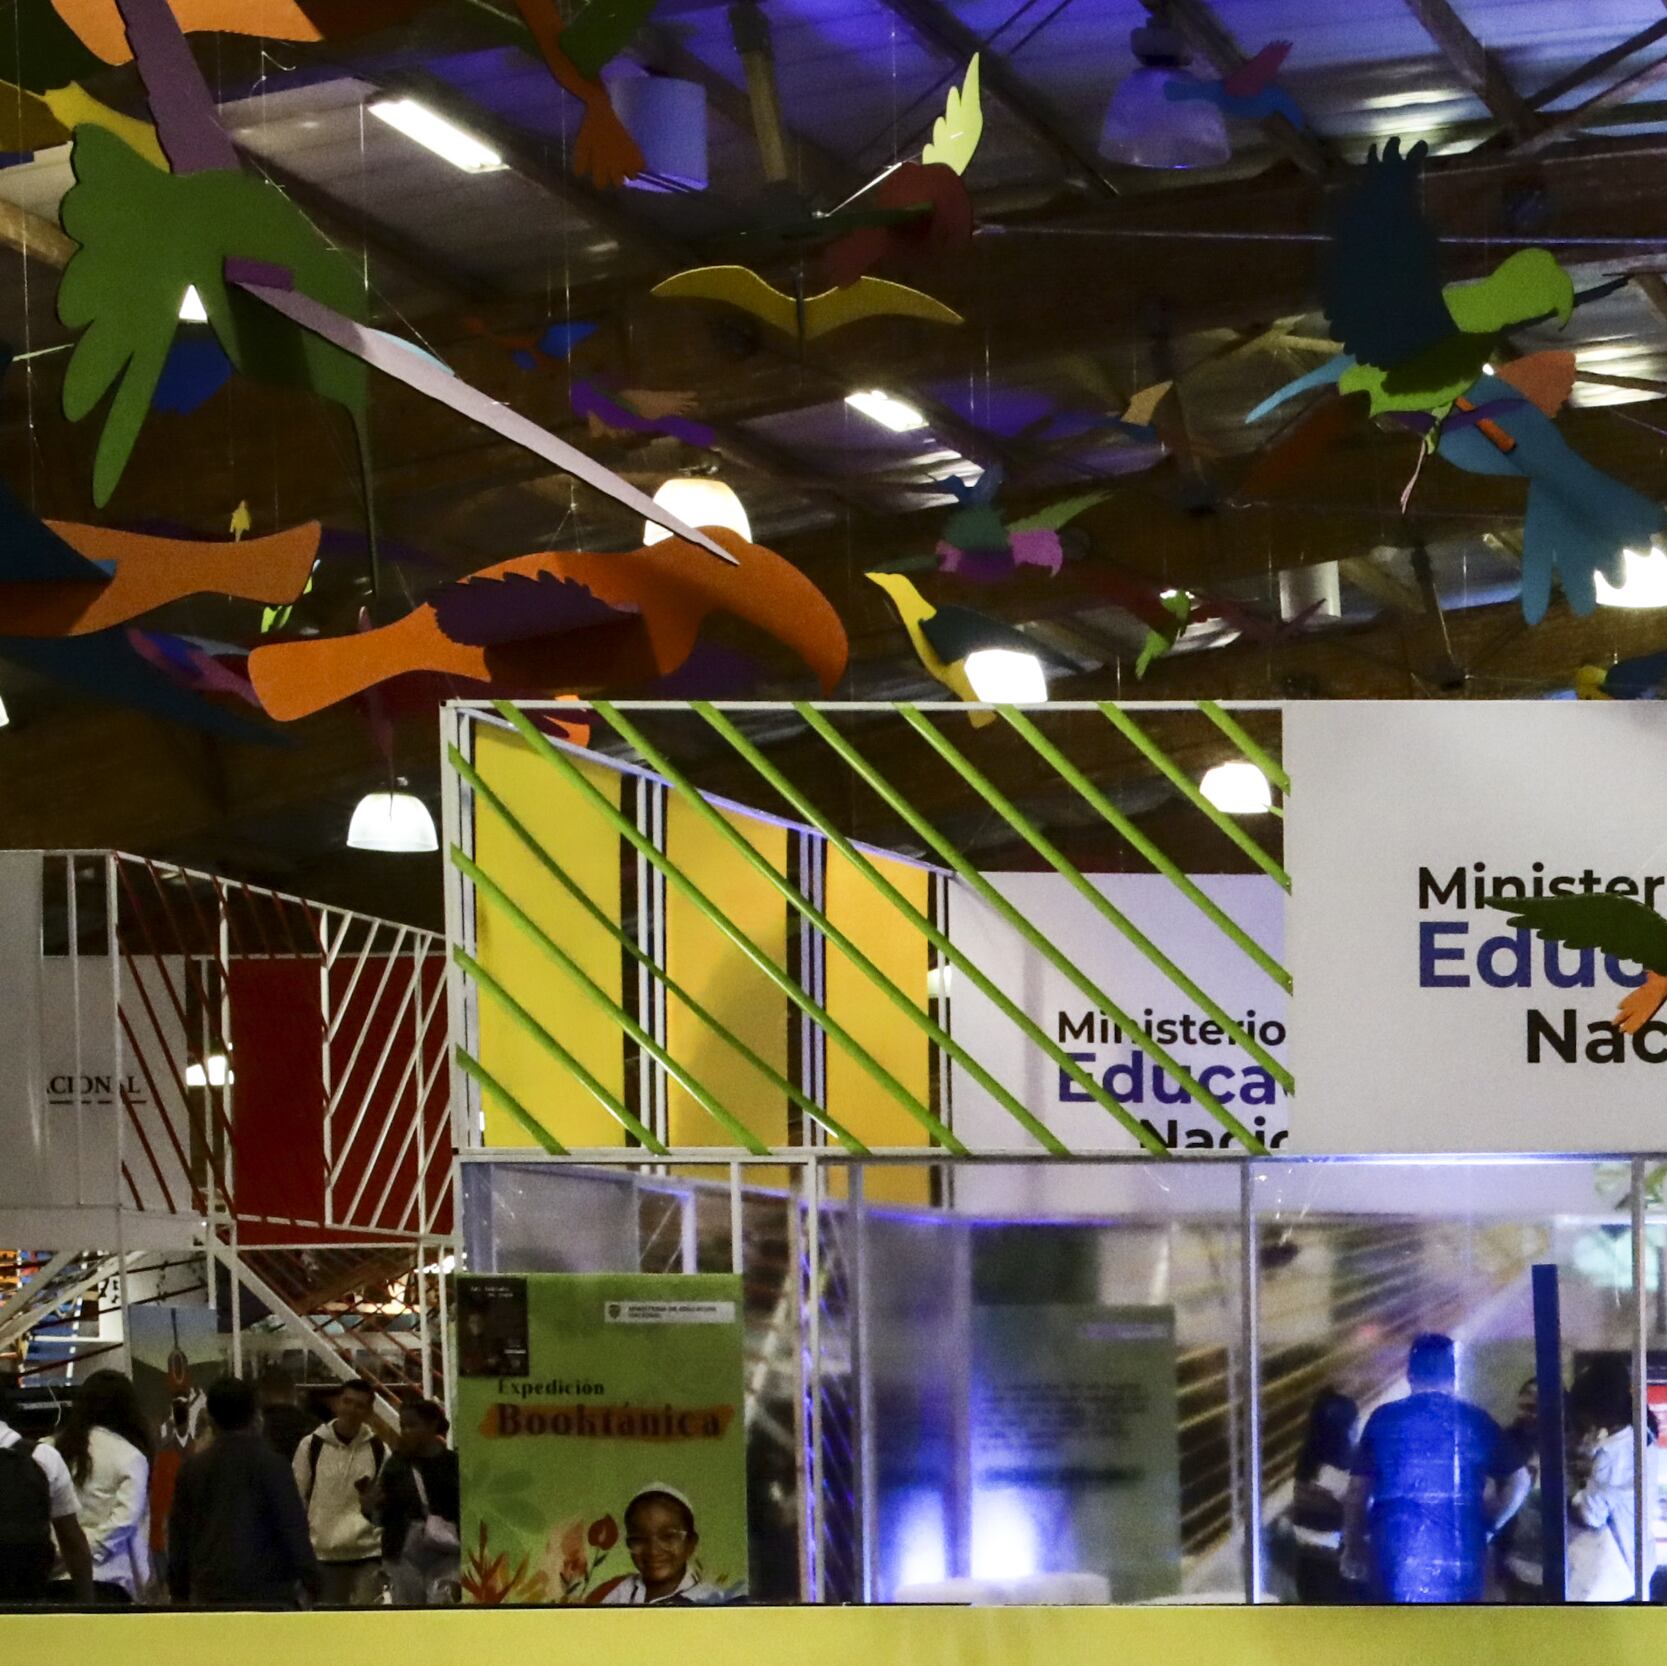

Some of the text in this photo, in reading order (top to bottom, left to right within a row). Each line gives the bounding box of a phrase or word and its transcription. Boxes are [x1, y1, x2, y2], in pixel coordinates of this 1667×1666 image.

[1057, 1009, 1287, 1046] Ministerio
[1057, 1051, 1288, 1105] Educa
[498, 1379, 605, 1399] Expedición
